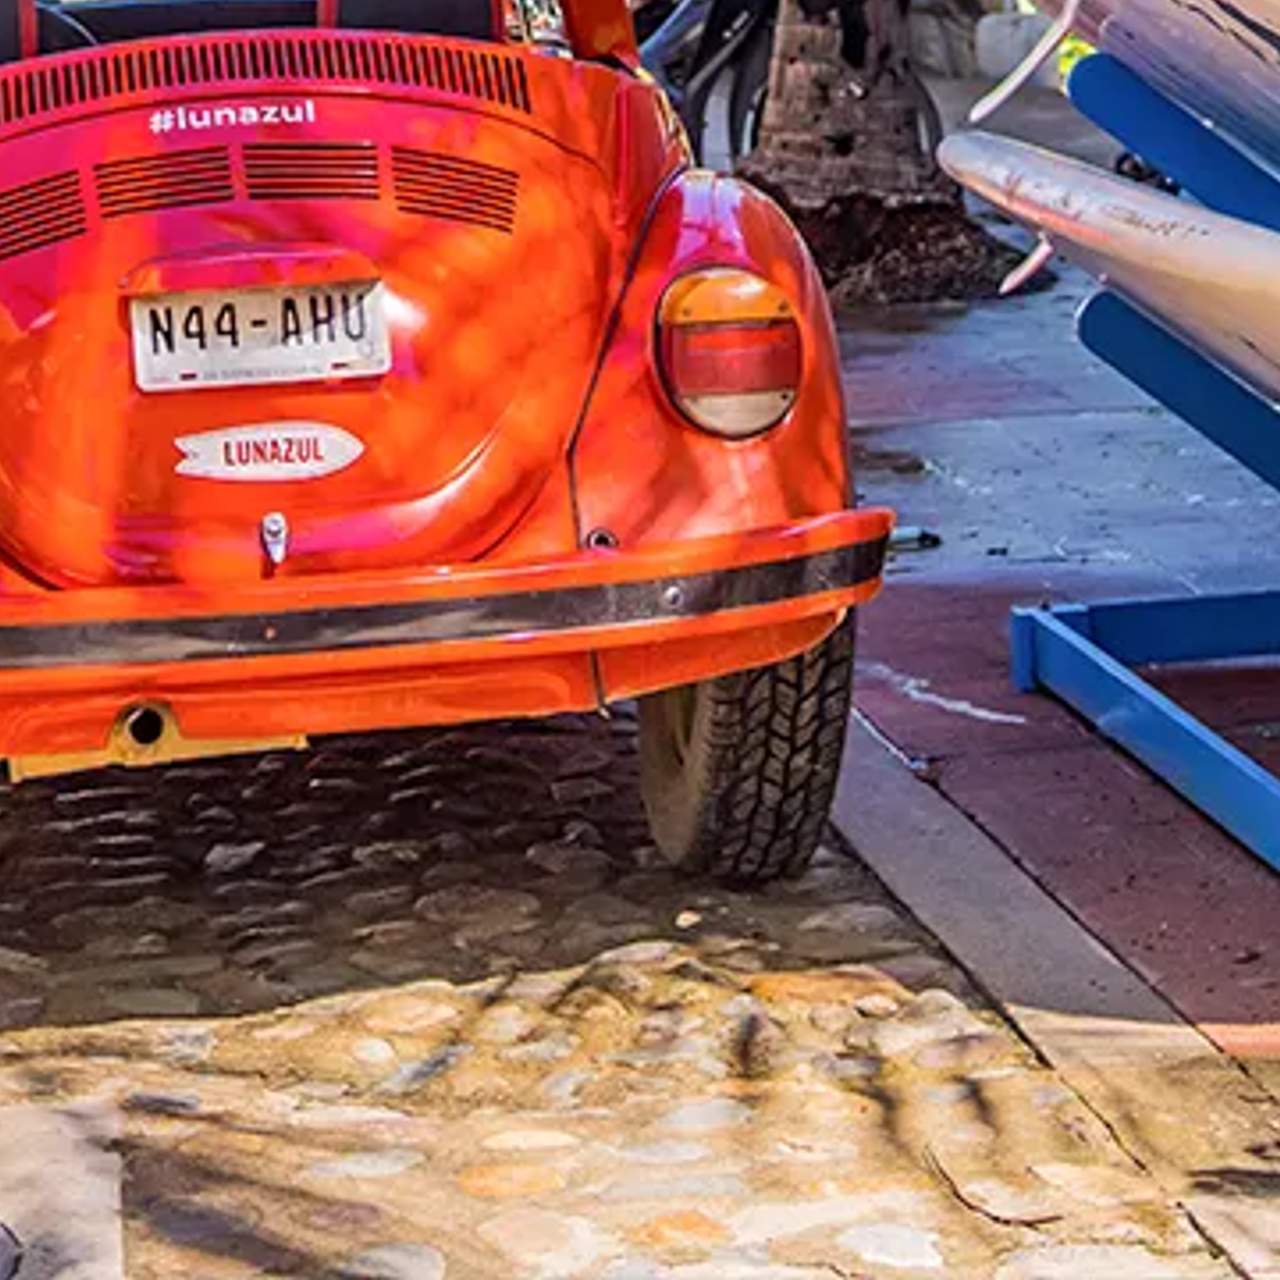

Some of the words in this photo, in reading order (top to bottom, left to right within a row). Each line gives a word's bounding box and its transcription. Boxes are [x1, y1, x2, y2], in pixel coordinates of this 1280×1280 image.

[148, 98, 316, 134] #lunazul
[149, 292, 365, 354] N44-AHU
[223, 436, 324, 466] LUNAZUL
